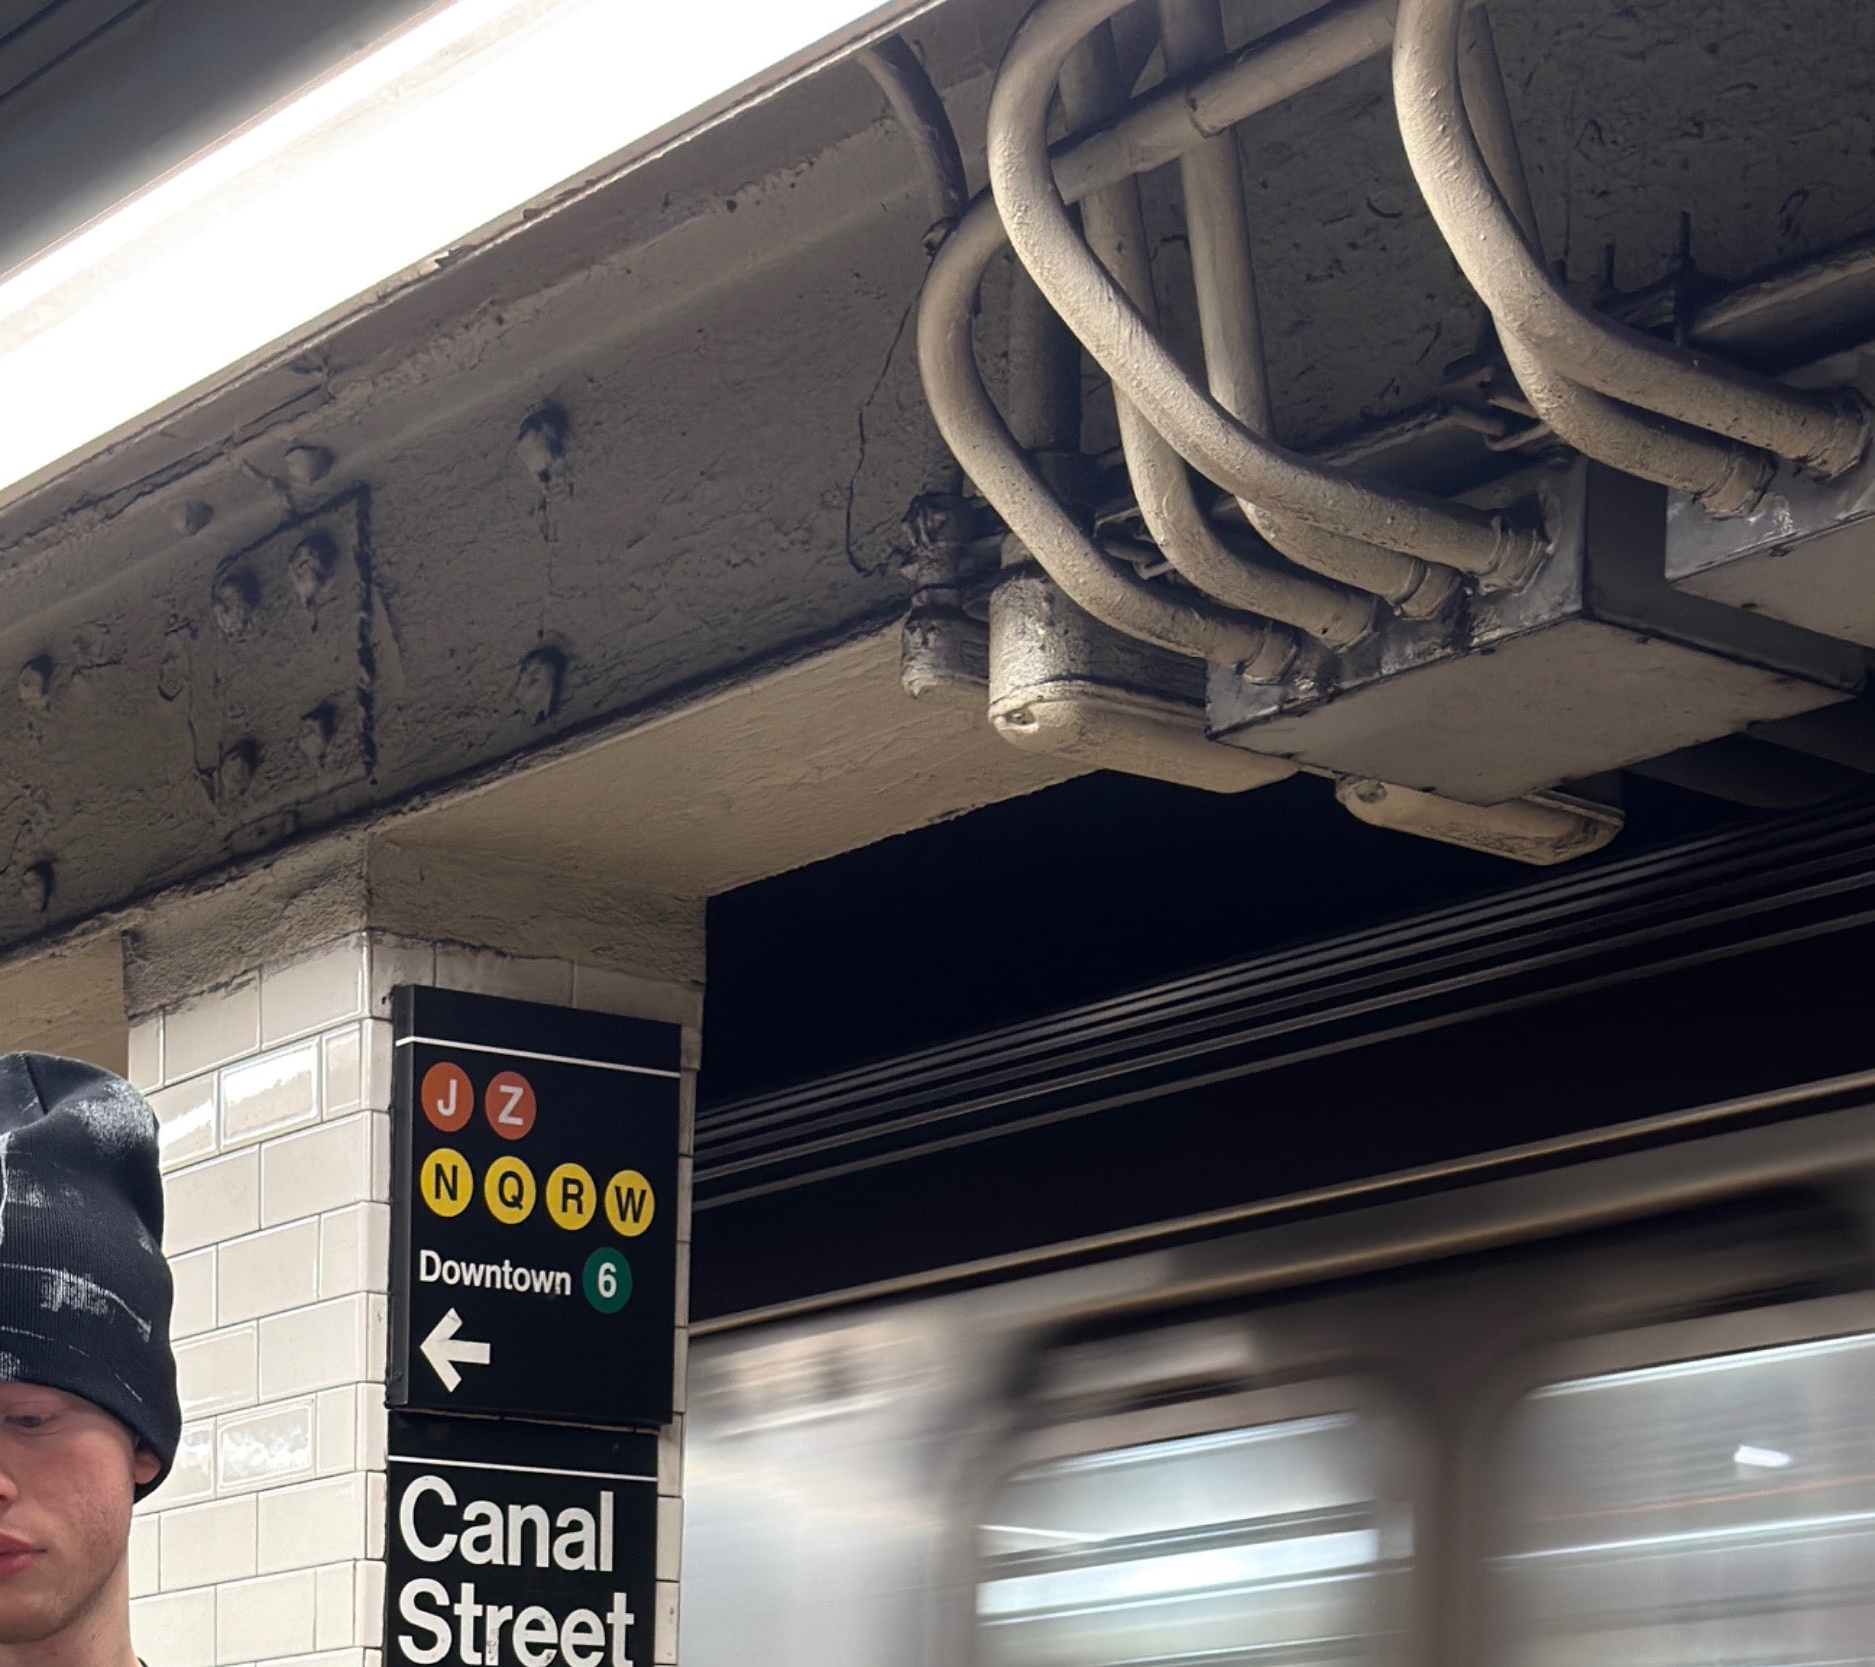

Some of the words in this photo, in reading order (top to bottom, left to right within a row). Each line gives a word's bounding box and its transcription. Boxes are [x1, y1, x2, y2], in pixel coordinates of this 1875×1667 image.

[436, 1078, 457, 1117] J
[498, 1084, 524, 1126] Z
[434, 1163, 458, 1201] N
[497, 1170, 524, 1211] Q
[562, 1178, 584, 1215] R
[615, 1186, 647, 1224] W
[419, 1249, 572, 1297] Downtown
[597, 1262, 618, 1298] 6
[399, 1475, 614, 1572] Canal
